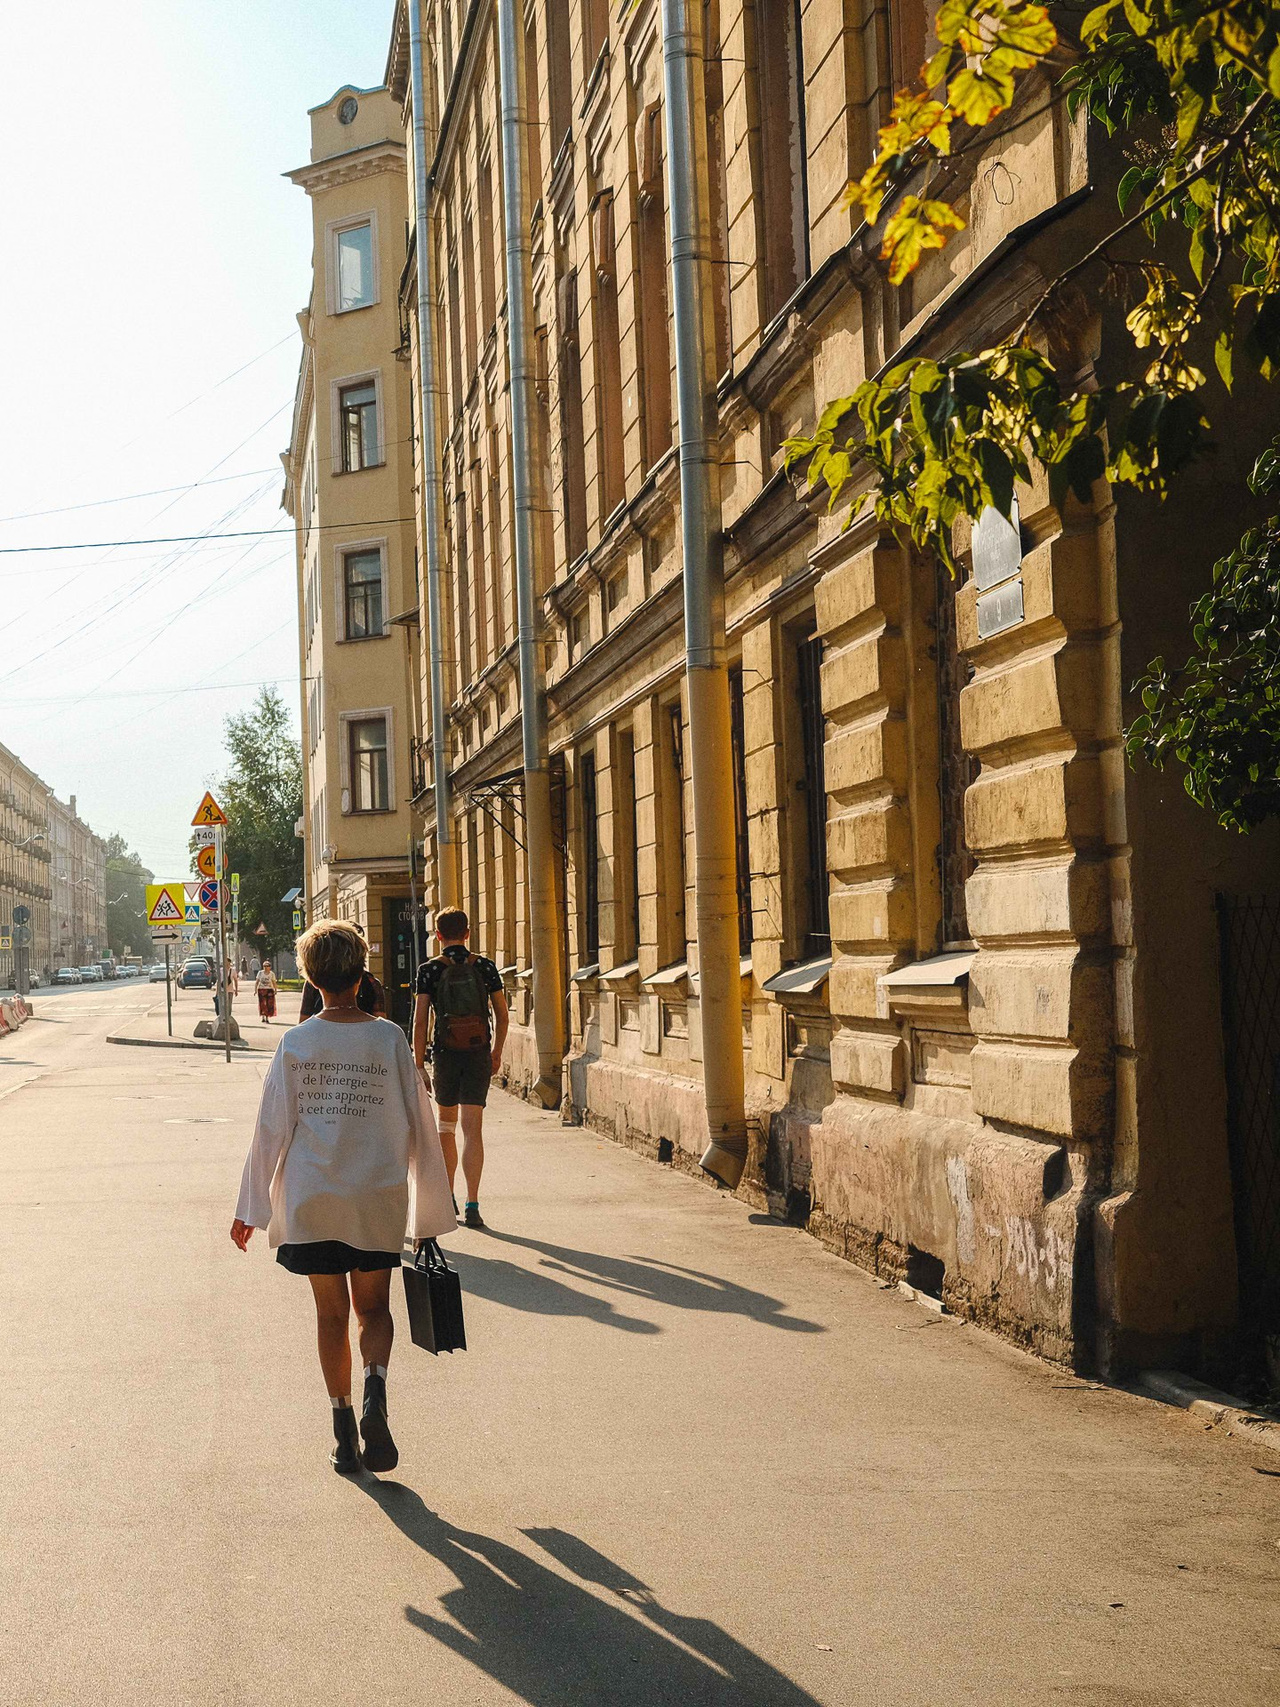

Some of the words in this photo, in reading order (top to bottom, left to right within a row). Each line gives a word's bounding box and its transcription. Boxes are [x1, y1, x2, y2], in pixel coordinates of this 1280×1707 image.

[319, 1062, 388, 1076] responsable
[302, 1074, 317, 1085] de
[320, 1074, 368, 1090] l'énergie
[307, 1091, 333, 1100] vous
[335, 1092, 384, 1105] apportez
[298, 1104, 304, 1114] à
[307, 1105, 326, 1114] cet
[326, 1104, 367, 1117] endroit
